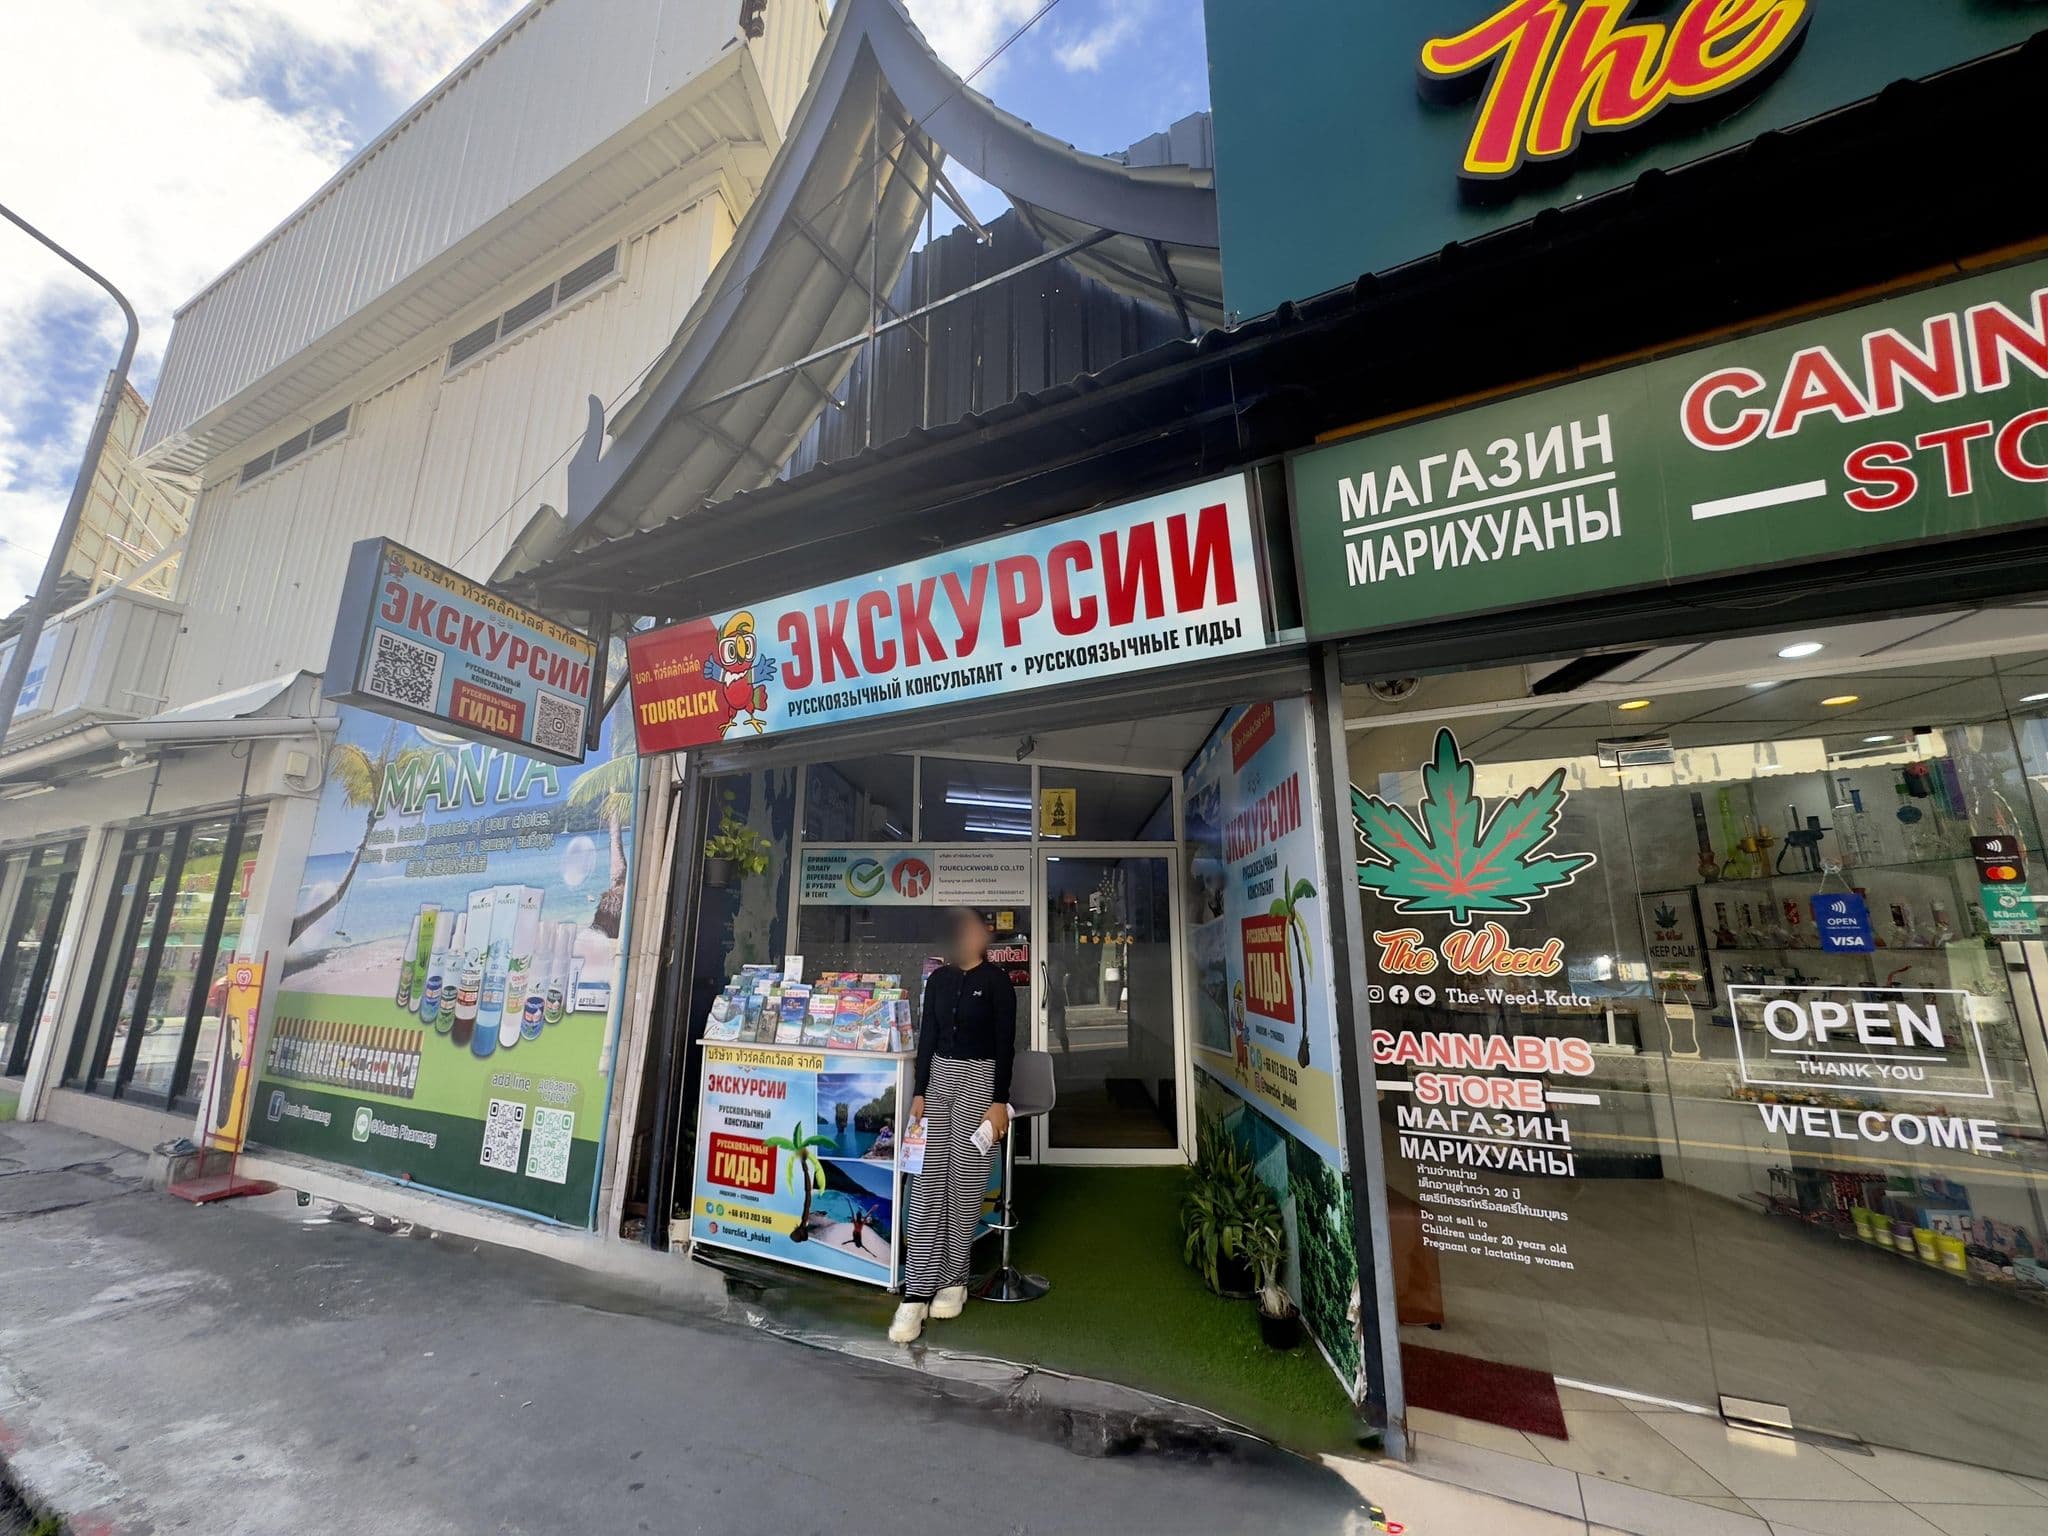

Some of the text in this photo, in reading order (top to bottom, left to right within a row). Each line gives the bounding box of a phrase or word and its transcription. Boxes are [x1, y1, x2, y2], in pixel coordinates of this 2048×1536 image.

[1421, 0, 1803, 174] The
[1338, 414, 1614, 522] МАГАЗИН
[1345, 488, 1622, 587] МАРИХУАНЫ
[776, 502, 1239, 691] ЭКСКУРСИИ
[381, 581, 590, 699] ЭКСКУРСИИ
[787, 617, 1242, 717] РУССКОЯЗЫЧНЫЙ КОНСУЛЬТАНТ РУССКОЯЗЫЧНЫЕ ГИДЫ
[457, 697, 516, 734] ГИДЫ
[640, 689, 719, 726] TOURCLICK
[1225, 772, 1302, 865] ЭКСКУРСИИ
[1827, 917, 1858, 926] OPEN
[1992, 909, 2030, 919] KBank
[986, 944, 1029, 963] ental
[1373, 922, 1565, 977] The Weed
[1650, 945, 1697, 958] KEEP CALM
[1829, 936, 1865, 946] VISA
[1248, 952, 1288, 1013] ГИДЫ
[1445, 988, 1591, 1008] The-Weed-Kata
[1763, 1000, 1947, 1049] OPEN
[1372, 1030, 1596, 1076] CANNABIS
[1796, 1060, 1925, 1082] THANK YOU
[708, 1074, 787, 1100] ЭКСКУРСИИ
[1415, 1072, 1547, 1113] STORE
[718, 1104, 771, 1119] РУССКОЯЗЫЧНЫЙ
[724, 1116, 764, 1131] КОНСУЛЬТАНТ
[1397, 1105, 1571, 1143] МАГАЗИН
[1757, 1103, 2003, 1152] WELCOME
[714, 1151, 768, 1187] ГИДЫ
[1400, 1135, 1576, 1177] МАРИХУАНЫ
[1494, 1187, 1509, 1199] 20
[1420, 1209, 1488, 1229] Do not sell to
[1421, 1223, 1568, 1255] Children under 20 years old
[1423, 1236, 1575, 1270] Pregnant or lactating women
